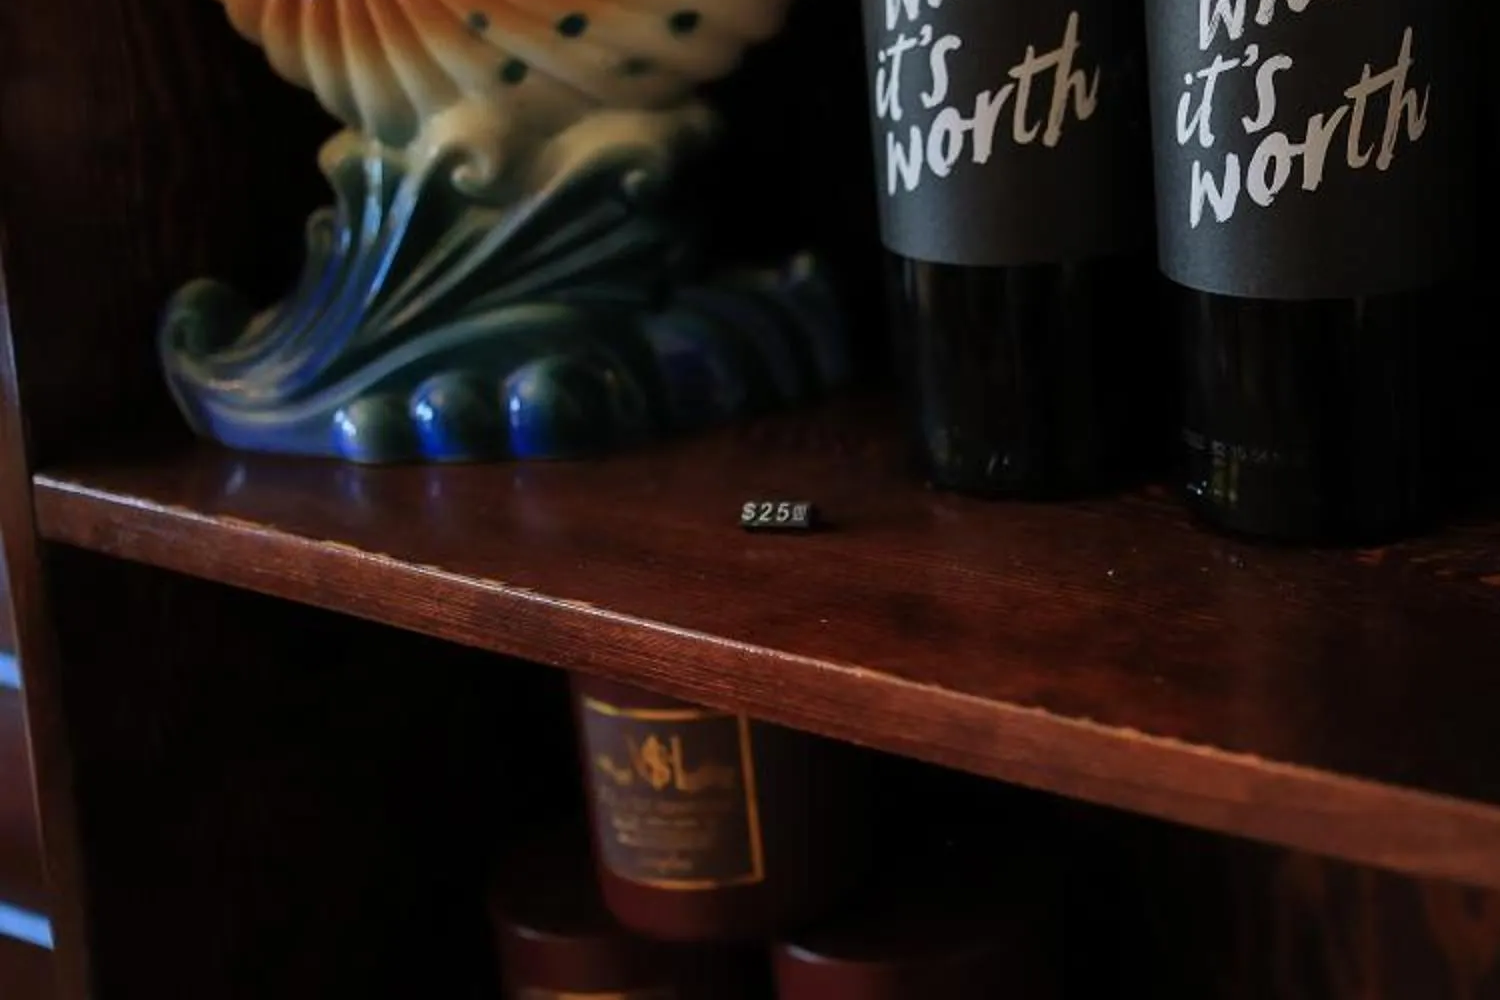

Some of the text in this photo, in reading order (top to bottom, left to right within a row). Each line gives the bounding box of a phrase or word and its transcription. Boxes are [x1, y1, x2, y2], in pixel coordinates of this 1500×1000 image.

[875, 23, 961, 121] it's
[886, 10, 1100, 197] worth
[1176, 43, 1293, 148] it's
[1189, 26, 1430, 230] worth
